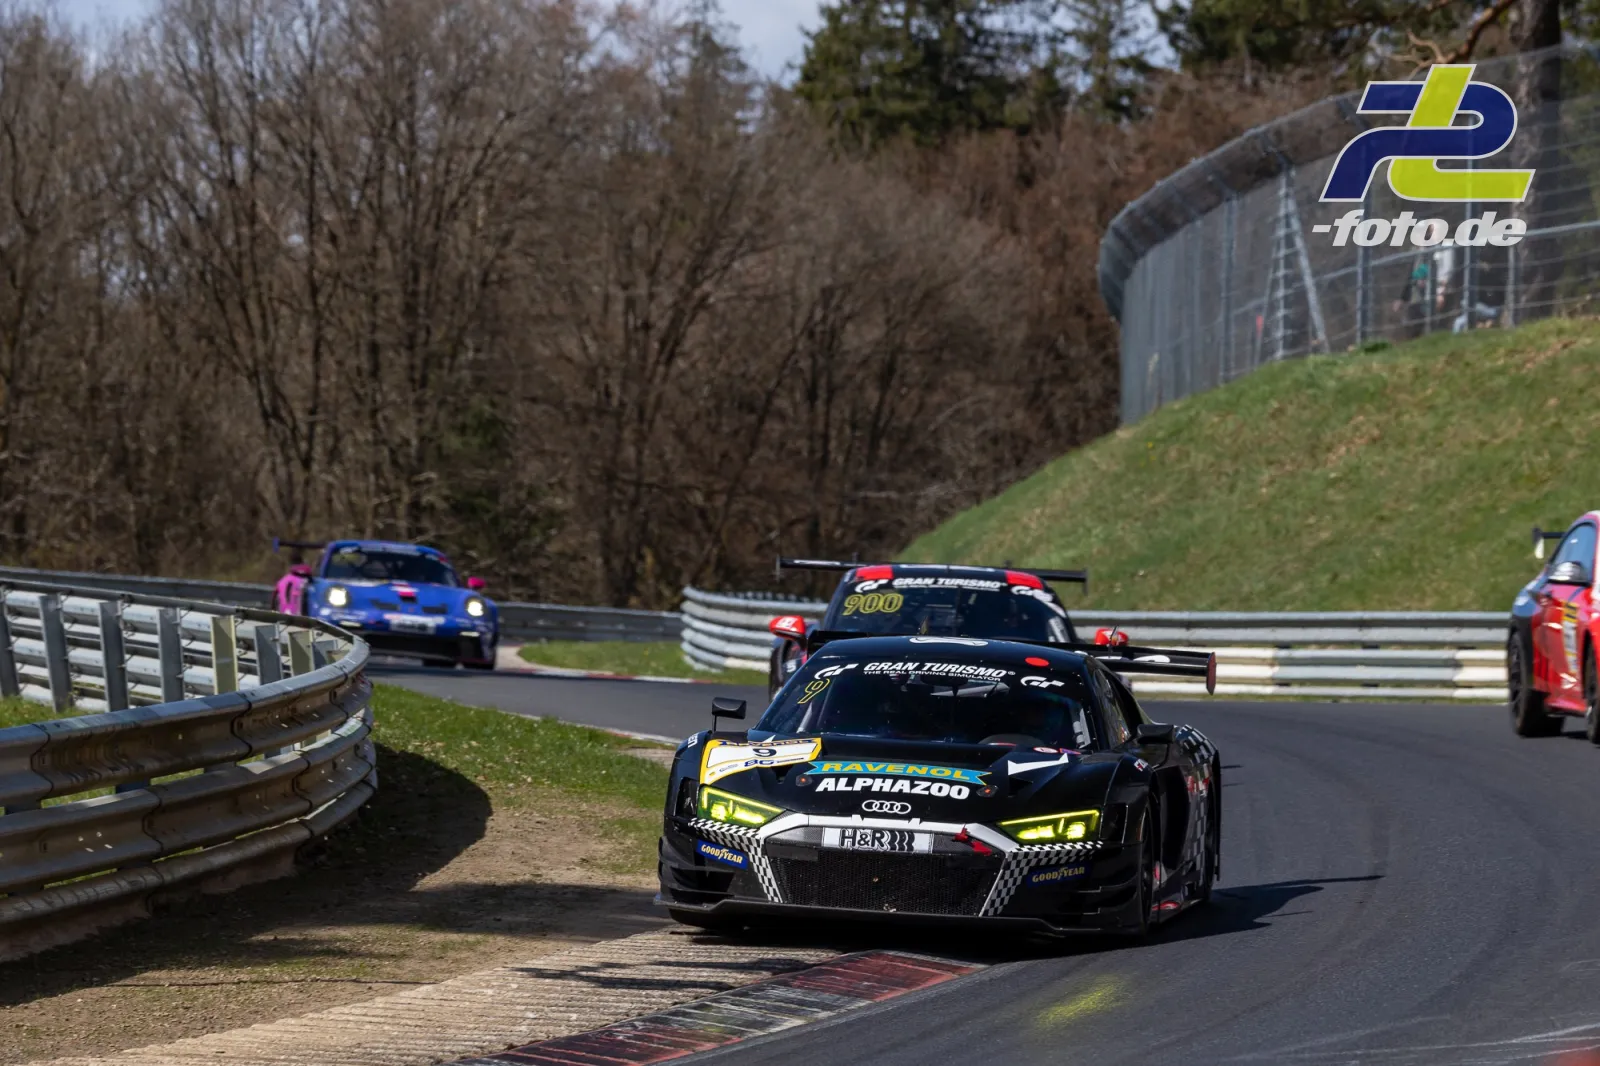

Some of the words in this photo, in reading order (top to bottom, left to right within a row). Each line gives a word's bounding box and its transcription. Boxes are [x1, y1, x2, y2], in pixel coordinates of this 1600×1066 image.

[892, 577, 936, 587] GRAN
[842, 592, 904, 616] 900
[863, 661, 921, 672] GRAN
[948, 672, 1001, 682] SIMULATOR
[796, 678, 831, 705] 9
[752, 748, 778, 758] 9
[821, 762, 972, 781] RAVENOL
[815, 777, 971, 800] ALPHAZOO
[839, 827, 886, 851] H&R
